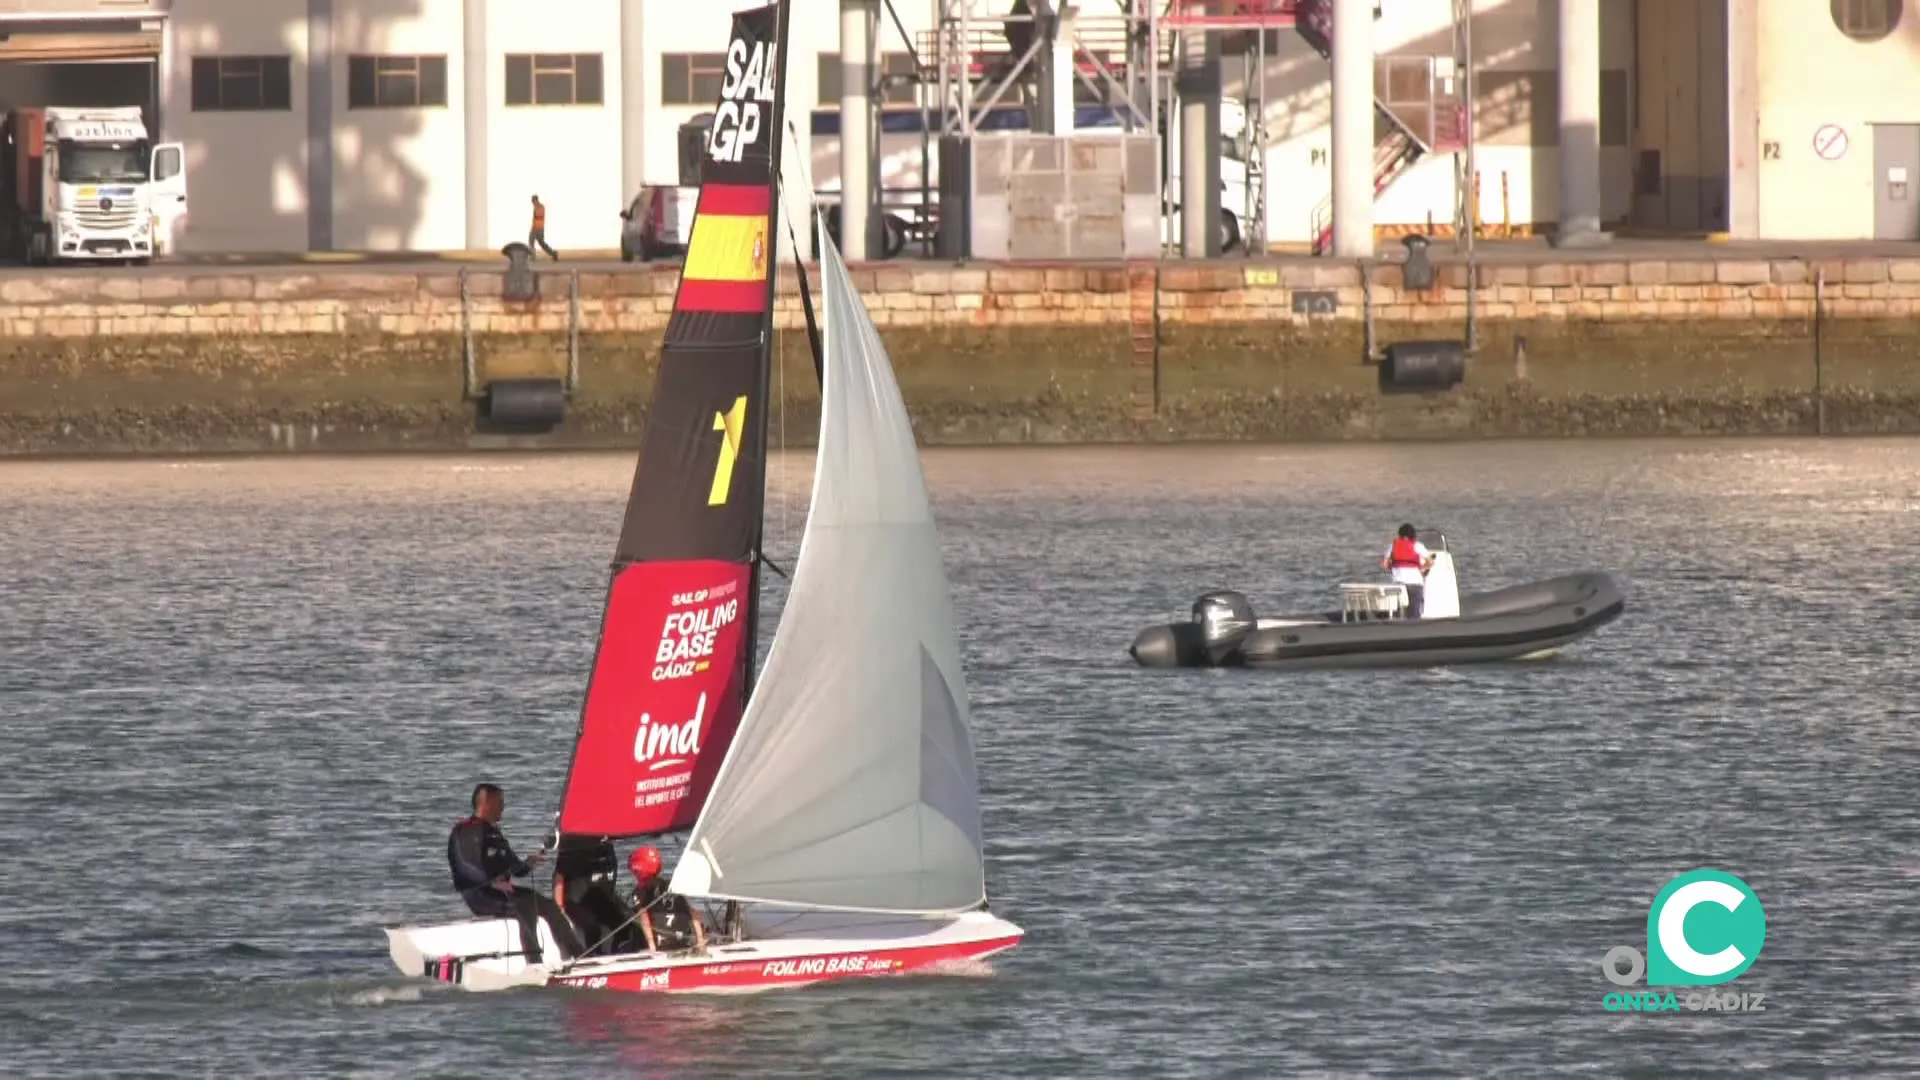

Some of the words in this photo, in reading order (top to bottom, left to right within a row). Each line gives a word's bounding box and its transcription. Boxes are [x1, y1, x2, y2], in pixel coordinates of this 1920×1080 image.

[709, 100, 760, 162] GP
[1311, 149, 1326, 166] P1
[1763, 142, 1780, 160] P2
[708, 395, 748, 506] 1
[661, 598, 738, 639] FOILING
[655, 630, 717, 663] BASE
[651, 660, 696, 681] CÁDIZ
[633, 692, 706, 762] imd
[665, 914, 675, 927] 7
[762, 959, 824, 977] FOILING
[825, 956, 868, 973] BASE
